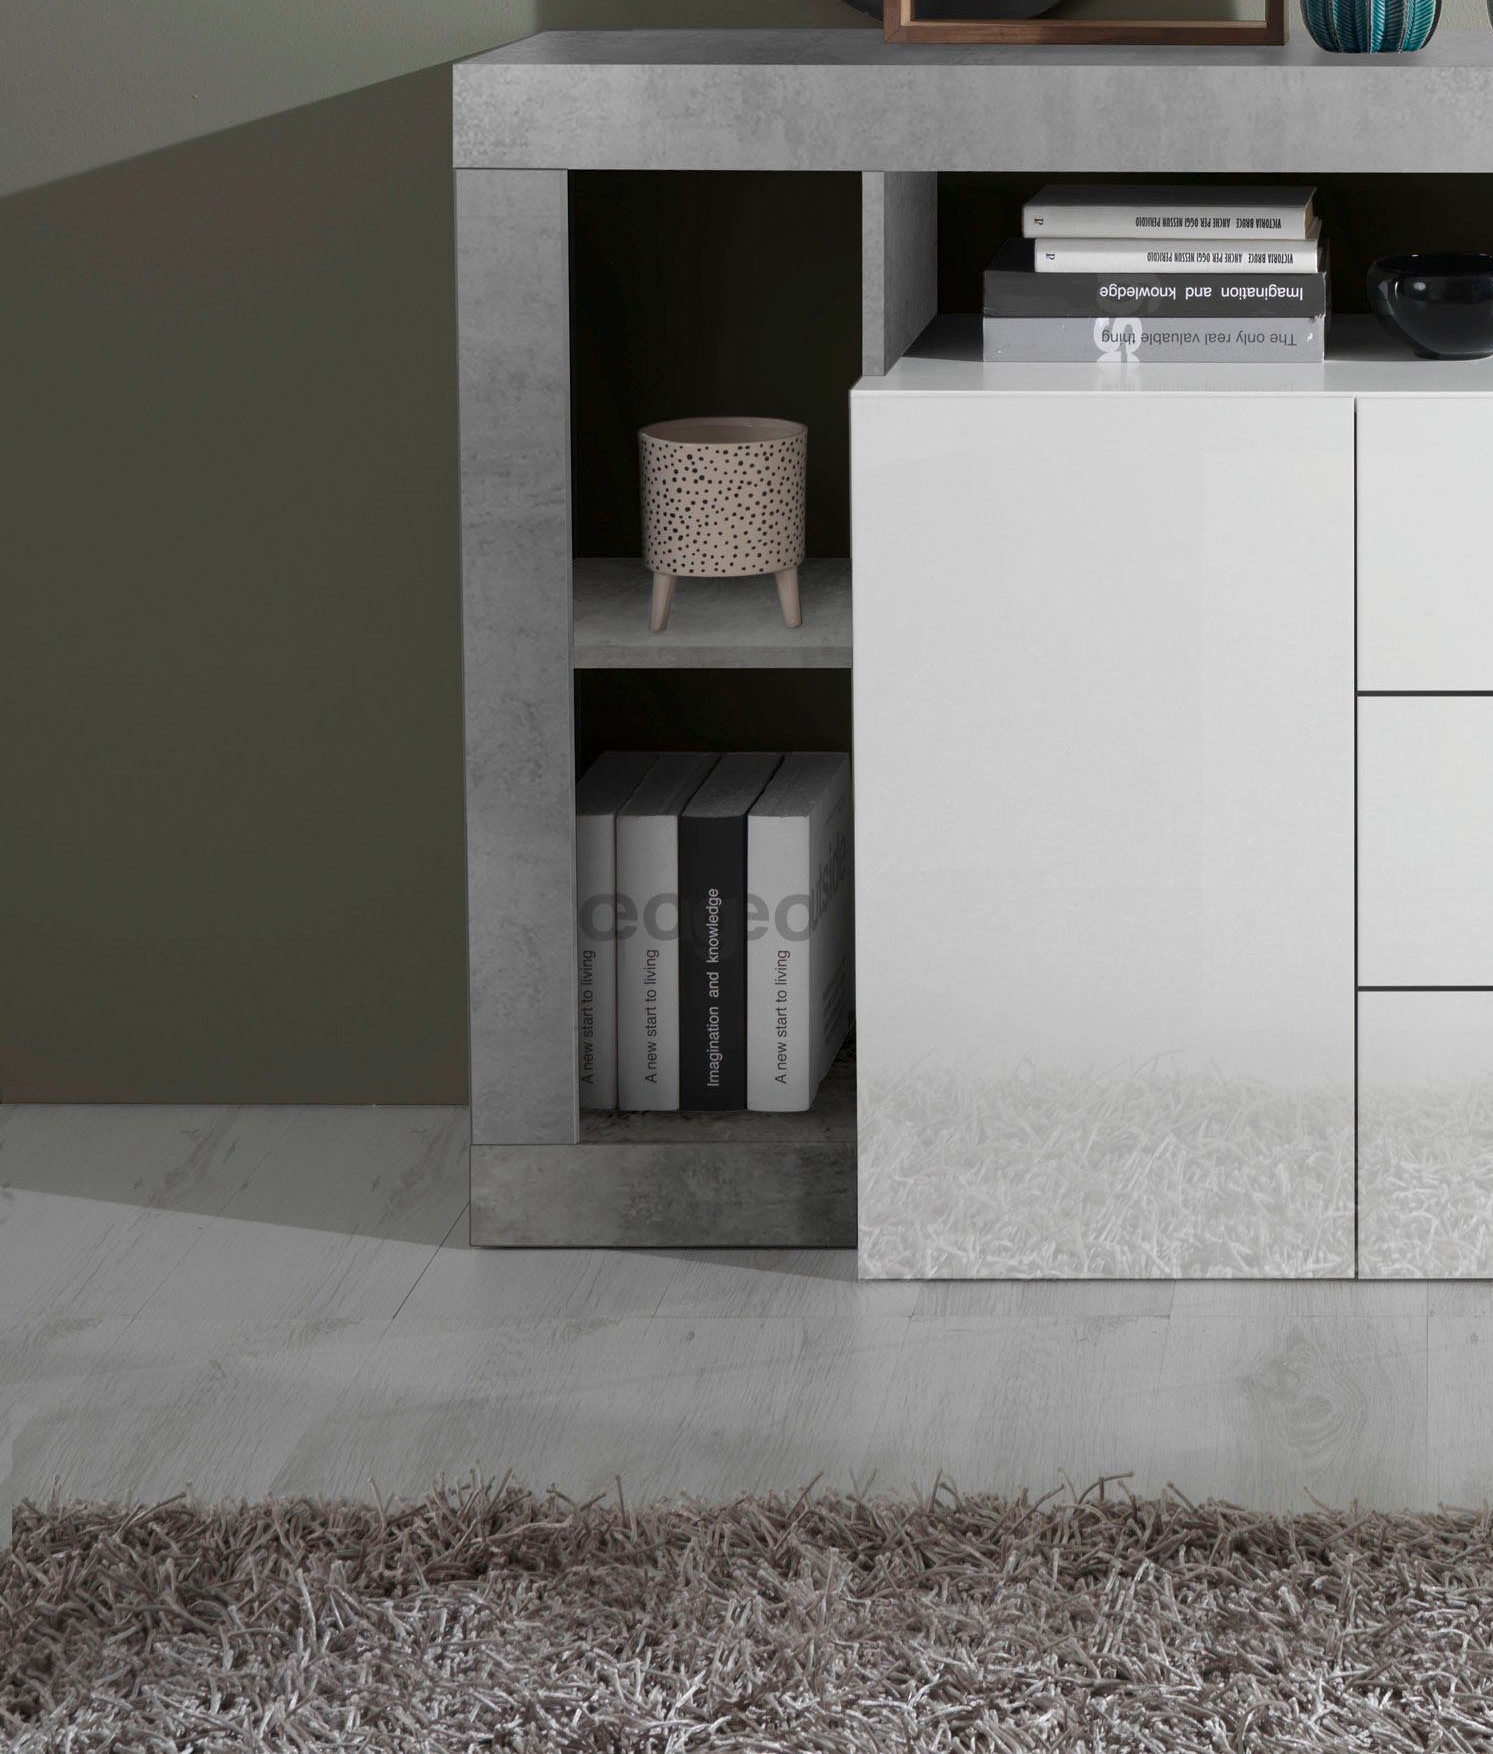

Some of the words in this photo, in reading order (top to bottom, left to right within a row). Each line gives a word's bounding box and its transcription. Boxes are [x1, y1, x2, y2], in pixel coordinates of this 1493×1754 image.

[1162, 217, 1182, 228] NESSUN
[1184, 217, 1198, 228] OGGI
[1200, 217, 1211, 228] PER
[1236, 218, 1254, 229] BRUCE
[1256, 218, 1281, 229] VICTORIA
[1174, 252, 1194, 263] NESSUN
[1196, 252, 1210, 263] OGGI
[1212, 252, 1223, 263] PER
[1248, 253, 1266, 264] BRUCE
[1267, 253, 1293, 264] VICTORIA
[1100, 284, 1176, 300] knowledge
[1185, 286, 1212, 301] and
[1221, 284, 1303, 301] Imagination
[1101, 330, 1137, 343] thing
[1141, 331, 1200, 345] valuable
[1205, 332, 1230, 345] real
[1235, 330, 1265, 345] only
[1270, 333, 1297, 346] The
[706, 888, 722, 963] knowledge
[580, 950, 596, 986] living
[644, 949, 660, 985] living
[774, 950, 790, 985] living
[706, 971, 719, 998] and
[581, 990, 593, 1003] to
[645, 989, 657, 1002] to
[776, 989, 787, 1003] to
[581, 1007, 594, 1038] start
[645, 1007, 657, 1037] start
[775, 1007, 787, 1037] start
[706, 1006, 723, 1087] Imagination
[583, 1042, 594, 1071] new
[647, 1041, 657, 1070] new
[777, 1042, 787, 1070] new
[581, 1073, 594, 1085] A
[645, 1073, 657, 1084] A
[775, 1073, 787, 1084] A
